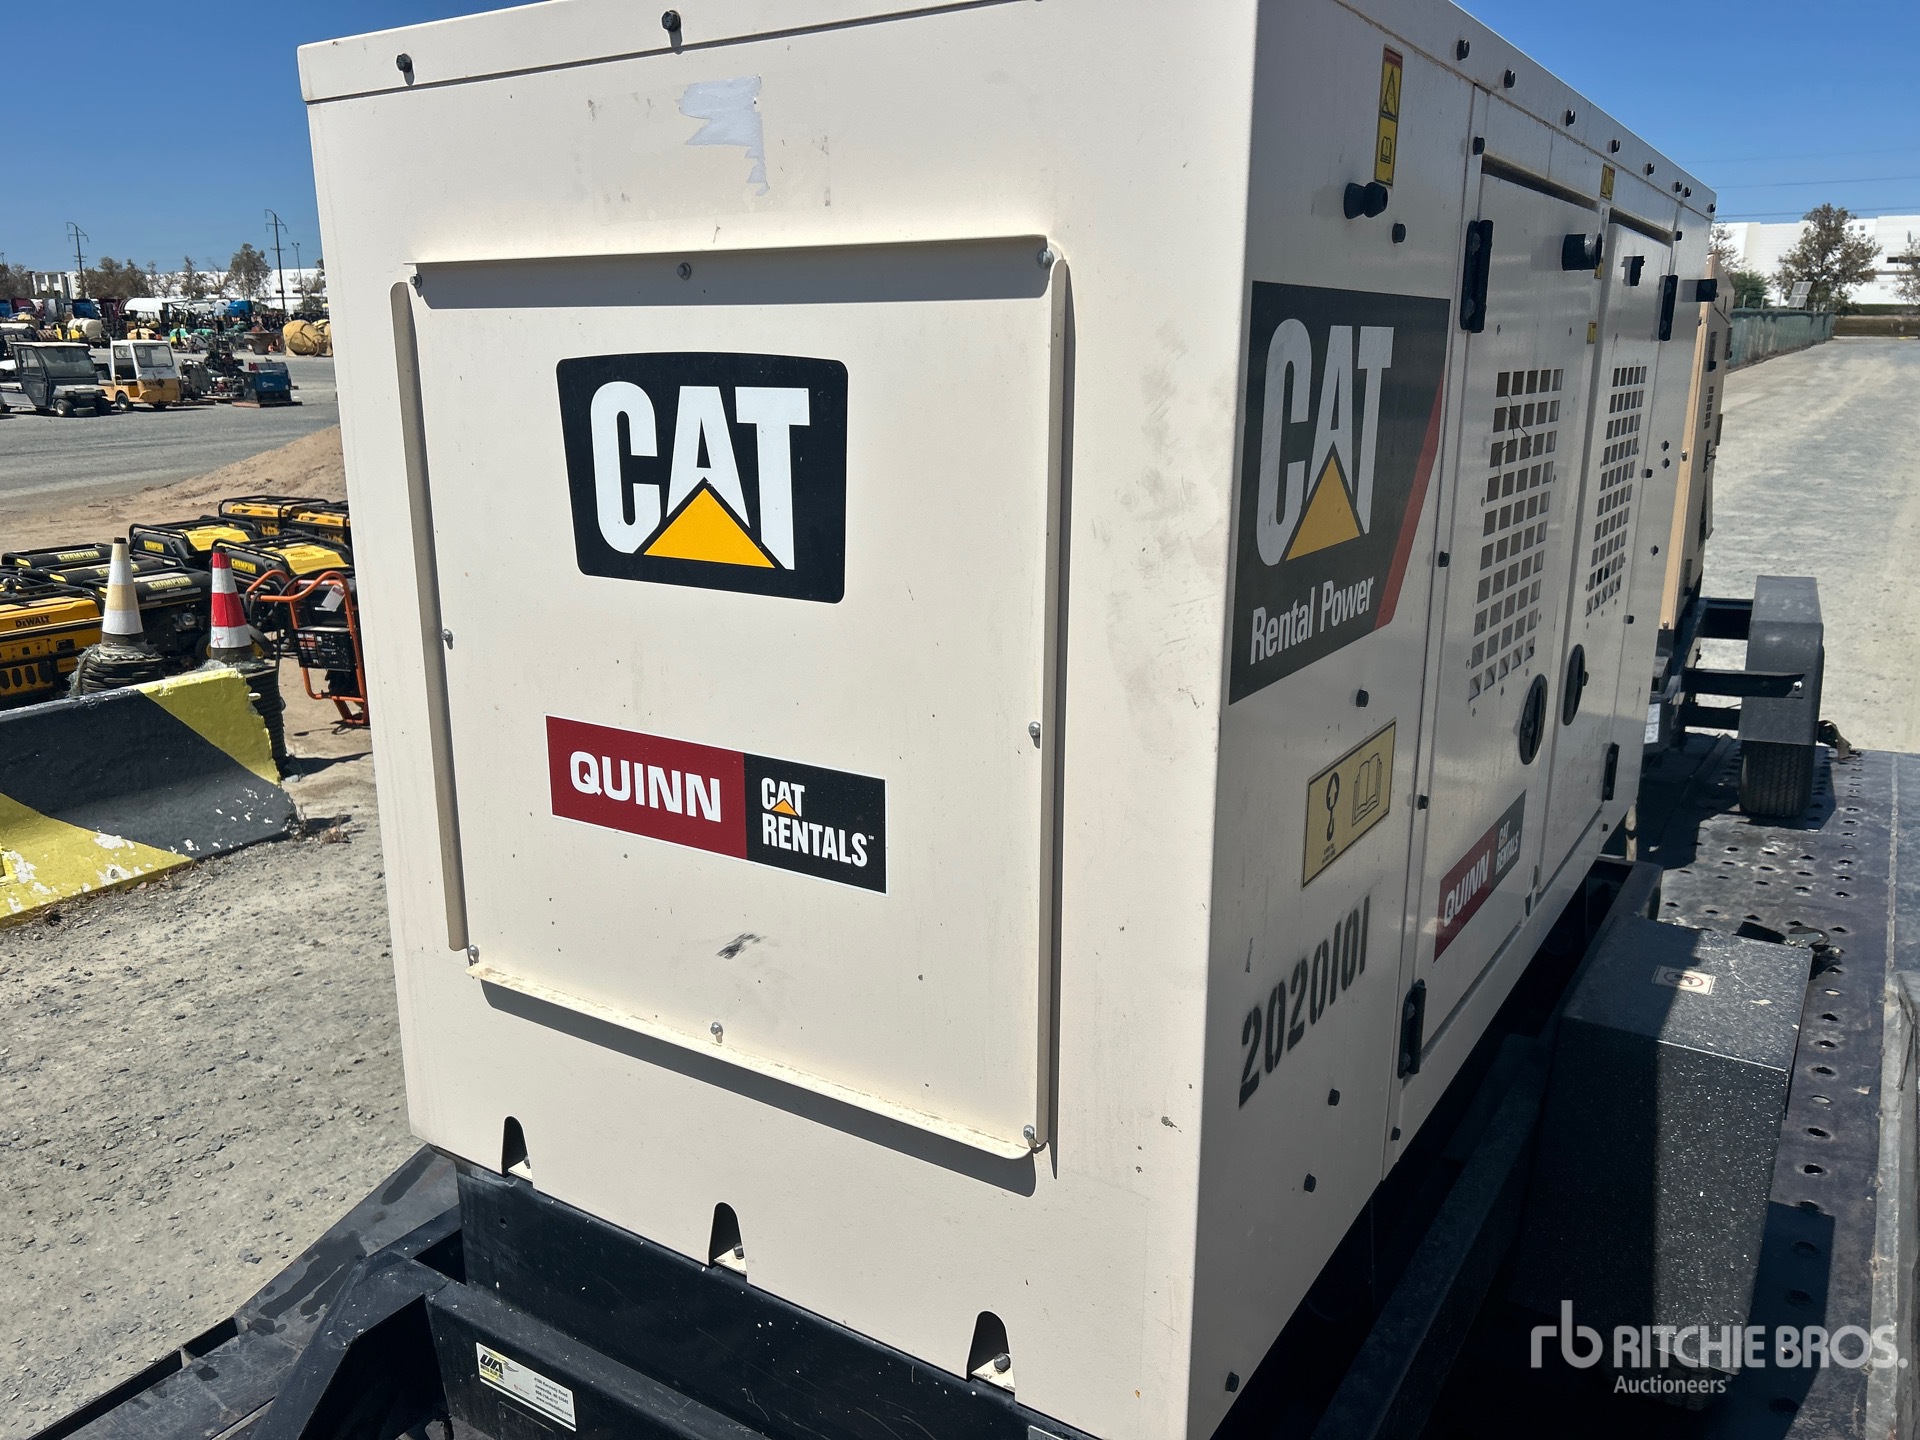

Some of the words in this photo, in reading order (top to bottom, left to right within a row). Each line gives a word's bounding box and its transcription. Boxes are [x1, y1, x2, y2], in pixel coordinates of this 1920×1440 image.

[1256, 318, 1394, 567] CAT
[590, 381, 811, 570] CAT
[57, 550, 100, 562] CHAMPION
[147, 576, 192, 591] CHAMPION
[1250, 586, 1315, 666] Rental
[1319, 576, 1374, 634] Power
[569, 751, 722, 823] QUINN
[761, 777, 805, 817] CAT
[762, 812, 868, 868] RENTALS
[1495, 830, 1520, 876] RENTALS
[1497, 820, 1510, 847] CAT
[1443, 849, 1490, 928] QUINN
[1238, 895, 1371, 1110] 2020101
[480, 1354, 504, 1374] UA
